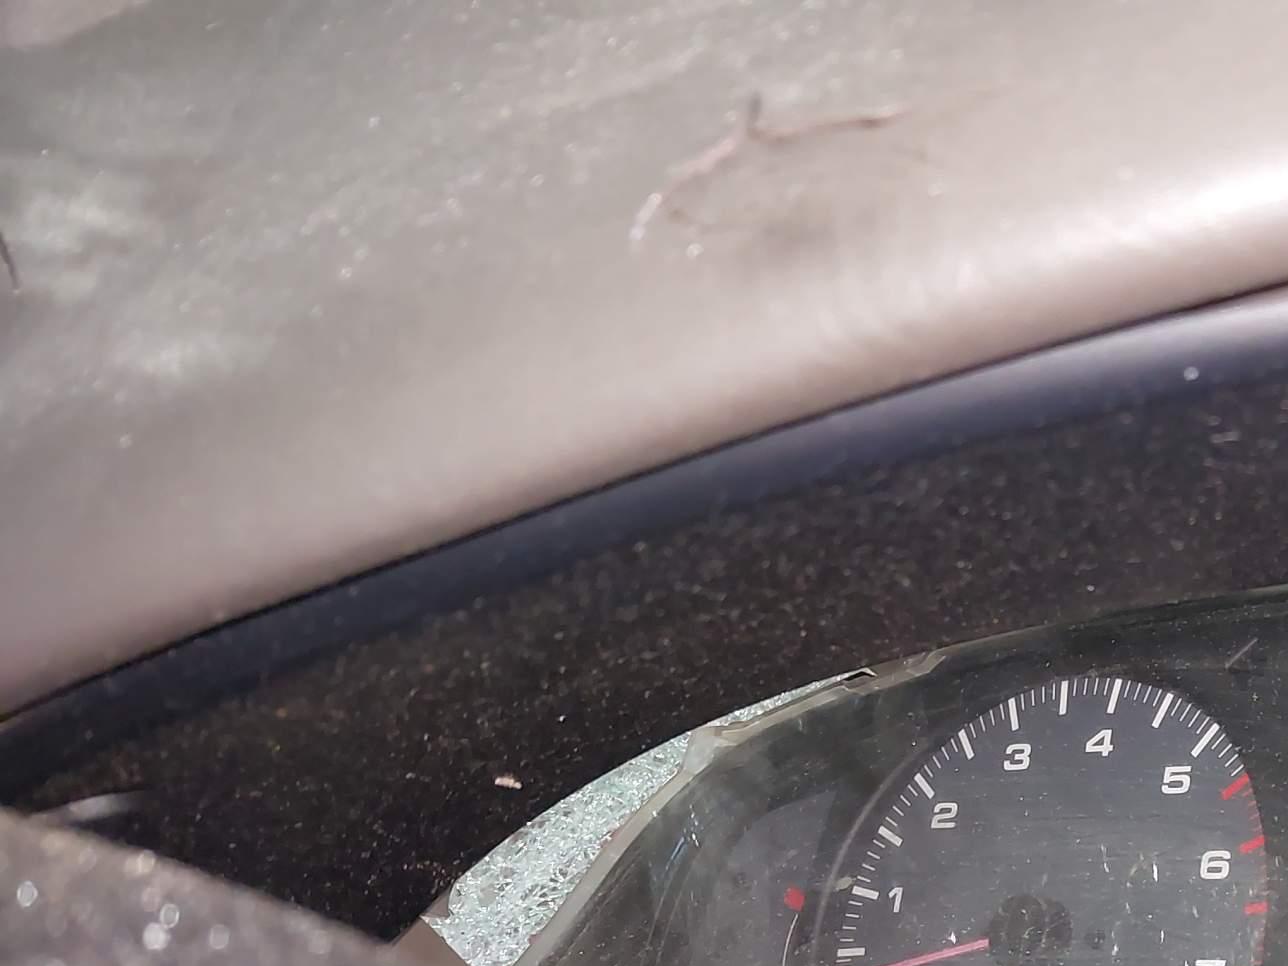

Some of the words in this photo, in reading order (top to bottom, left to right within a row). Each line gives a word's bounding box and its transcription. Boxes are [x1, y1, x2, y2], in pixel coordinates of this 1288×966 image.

[1085, 730, 1113, 756] 4
[1004, 744, 1031, 770] 3
[1161, 765, 1191, 794] 5
[931, 802, 958, 828] 2
[1199, 850, 1231, 879] 6
[888, 887, 903, 912] 1
